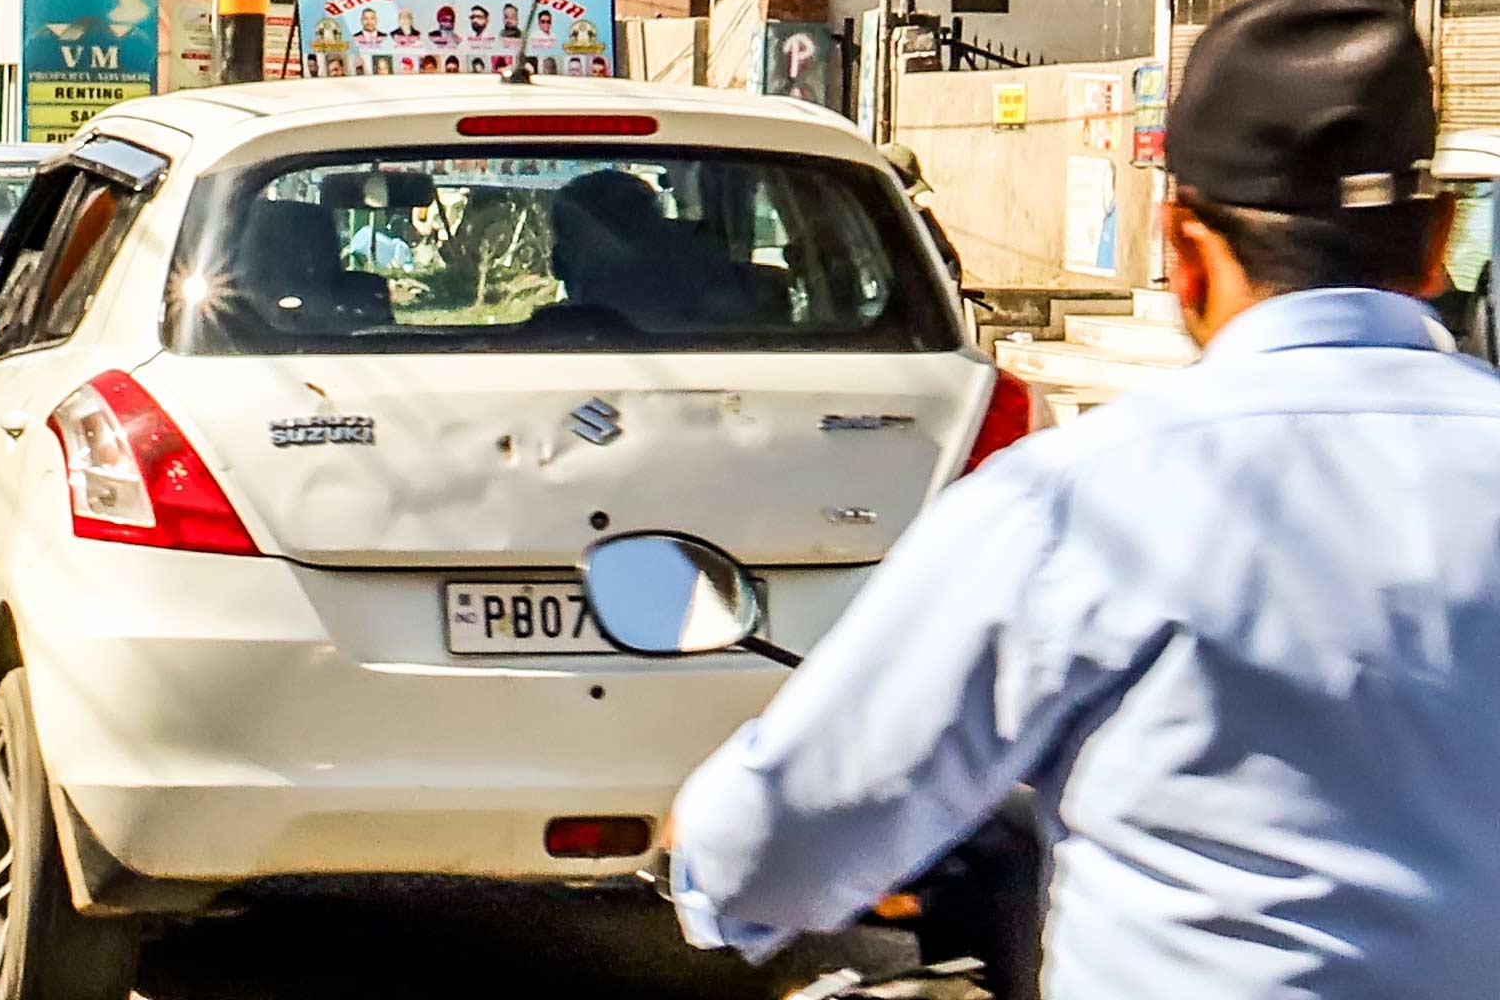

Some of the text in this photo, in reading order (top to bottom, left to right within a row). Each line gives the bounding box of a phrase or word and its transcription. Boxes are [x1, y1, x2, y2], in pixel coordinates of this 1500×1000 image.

[55, 87, 124, 99] RENTING
[270, 427, 375, 446] SUZUKI
[484, 595, 593, 639] PB07
